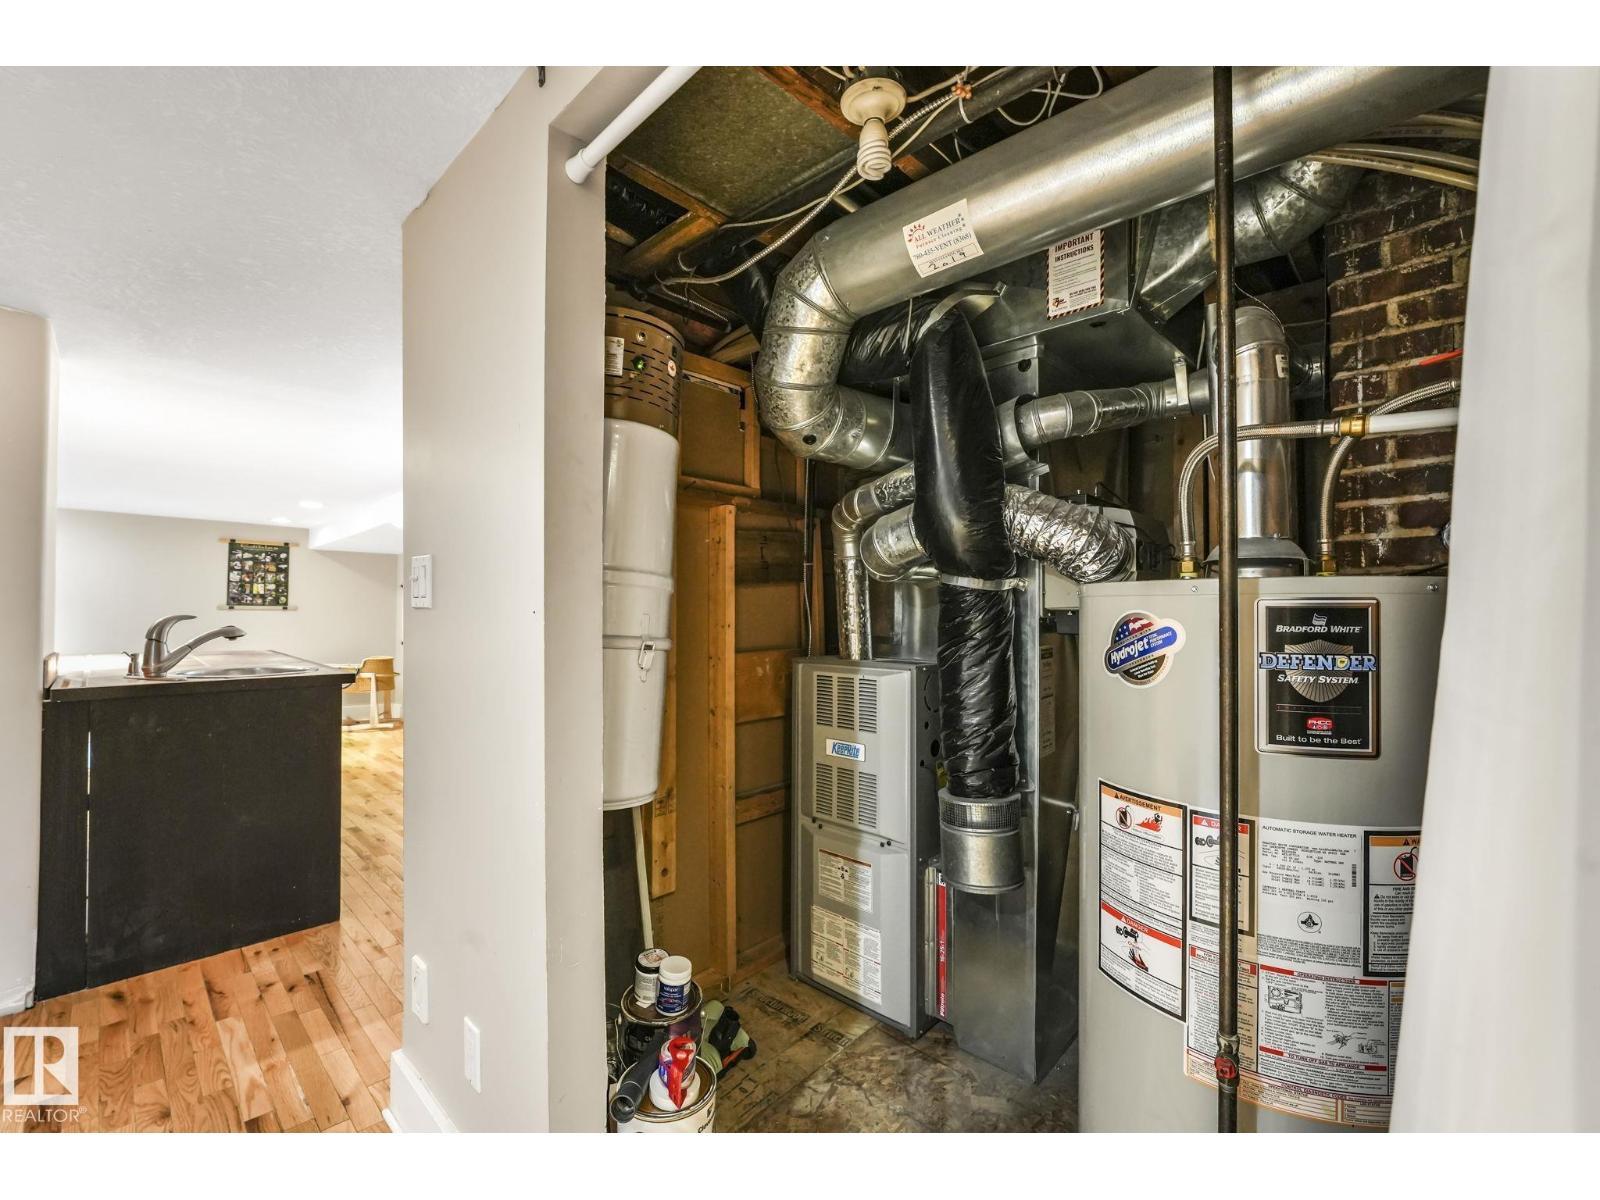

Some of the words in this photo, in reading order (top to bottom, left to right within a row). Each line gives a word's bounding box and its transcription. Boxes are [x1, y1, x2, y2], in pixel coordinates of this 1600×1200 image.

[926, 217, 961, 237] WEATHER
[1054, 232, 1094, 253] IMPORTANT
[1054, 244, 1094, 262] INSTRUCTIONS
[1275, 624, 1328, 633] BRADFORD
[1330, 625, 1361, 633] WHITE
[1109, 636, 1150, 666] Hydrojet
[1259, 652, 1377, 671] DEFENDER
[1276, 673, 1317, 683] SAFETY
[1318, 675, 1359, 684] SYSTEM
[1275, 734, 1296, 742] Built
[1298, 735, 1308, 743] to
[1340, 737, 1361, 745] Best
[1119, 794, 1162, 811] AVERTISSEMENT
[1262, 825, 1292, 833] AUTOMATIC
